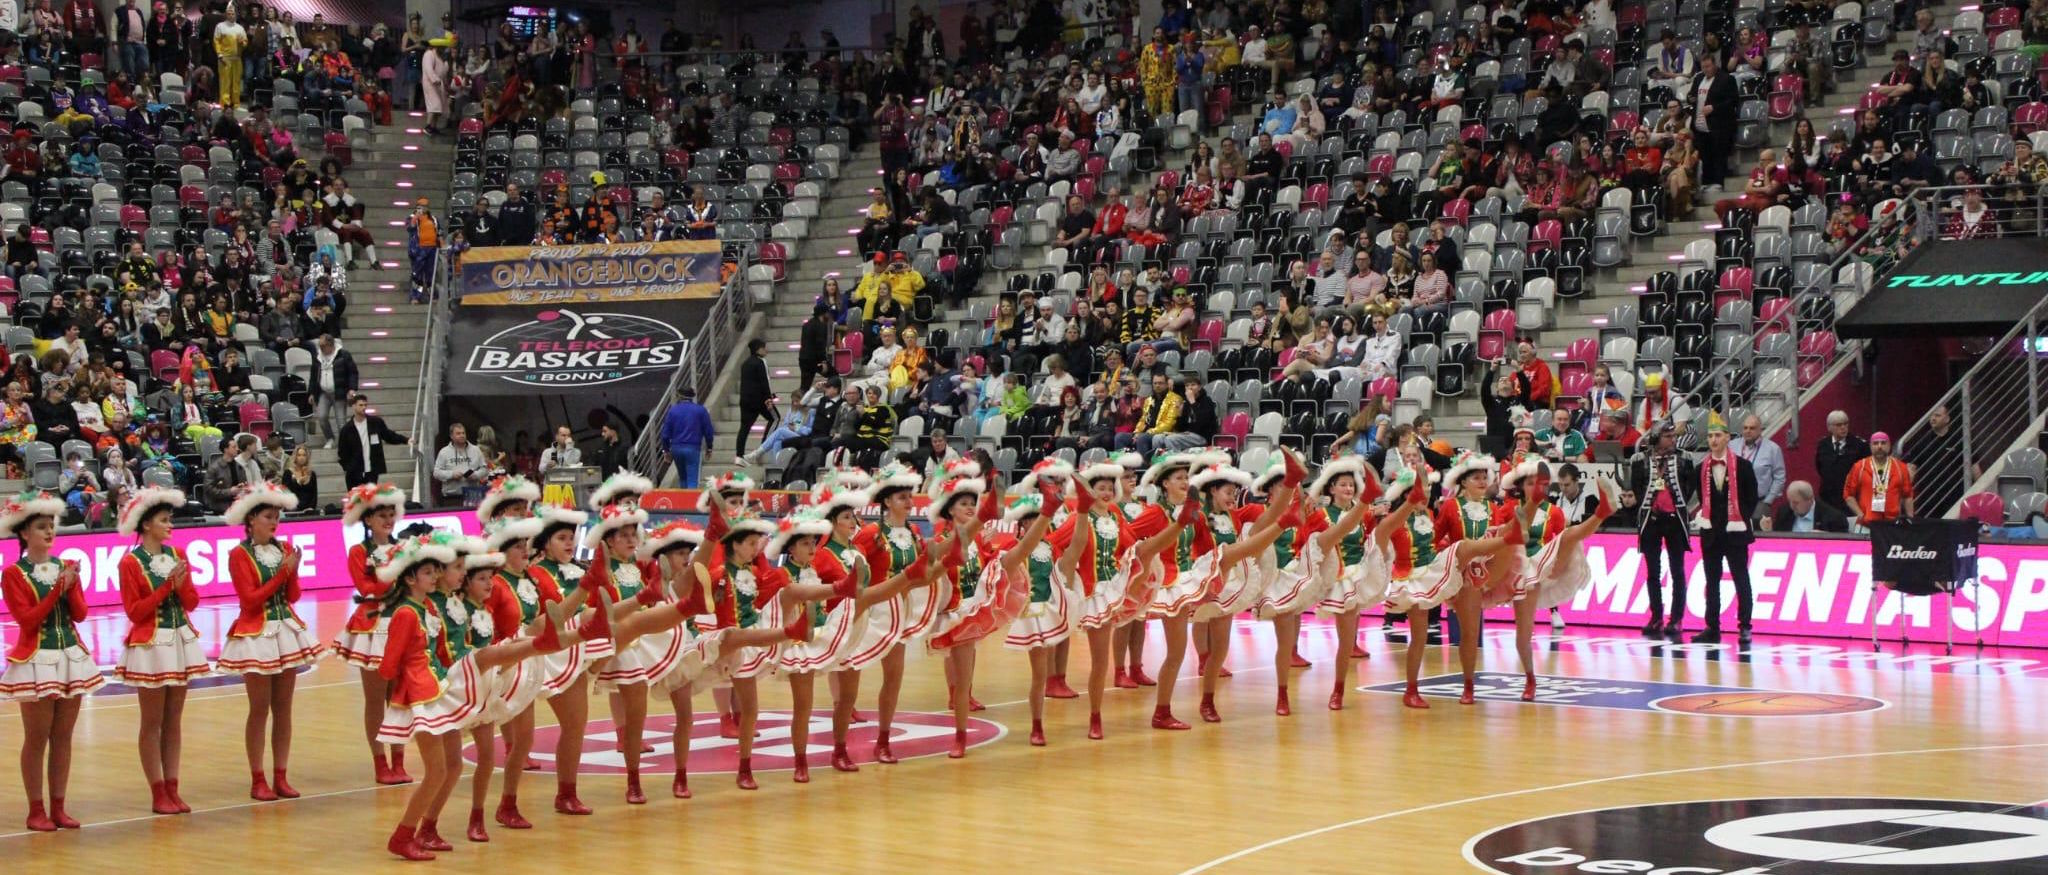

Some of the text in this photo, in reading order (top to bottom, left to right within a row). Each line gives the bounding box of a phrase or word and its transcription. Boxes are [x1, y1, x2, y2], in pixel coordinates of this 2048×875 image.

[491, 255, 697, 289] ORANGEBLOCK
[518, 337, 653, 351] TELEKOM
[480, 345, 675, 369] BASKETS
[540, 372, 604, 382] BONN
[1886, 544, 1938, 559] Baden
